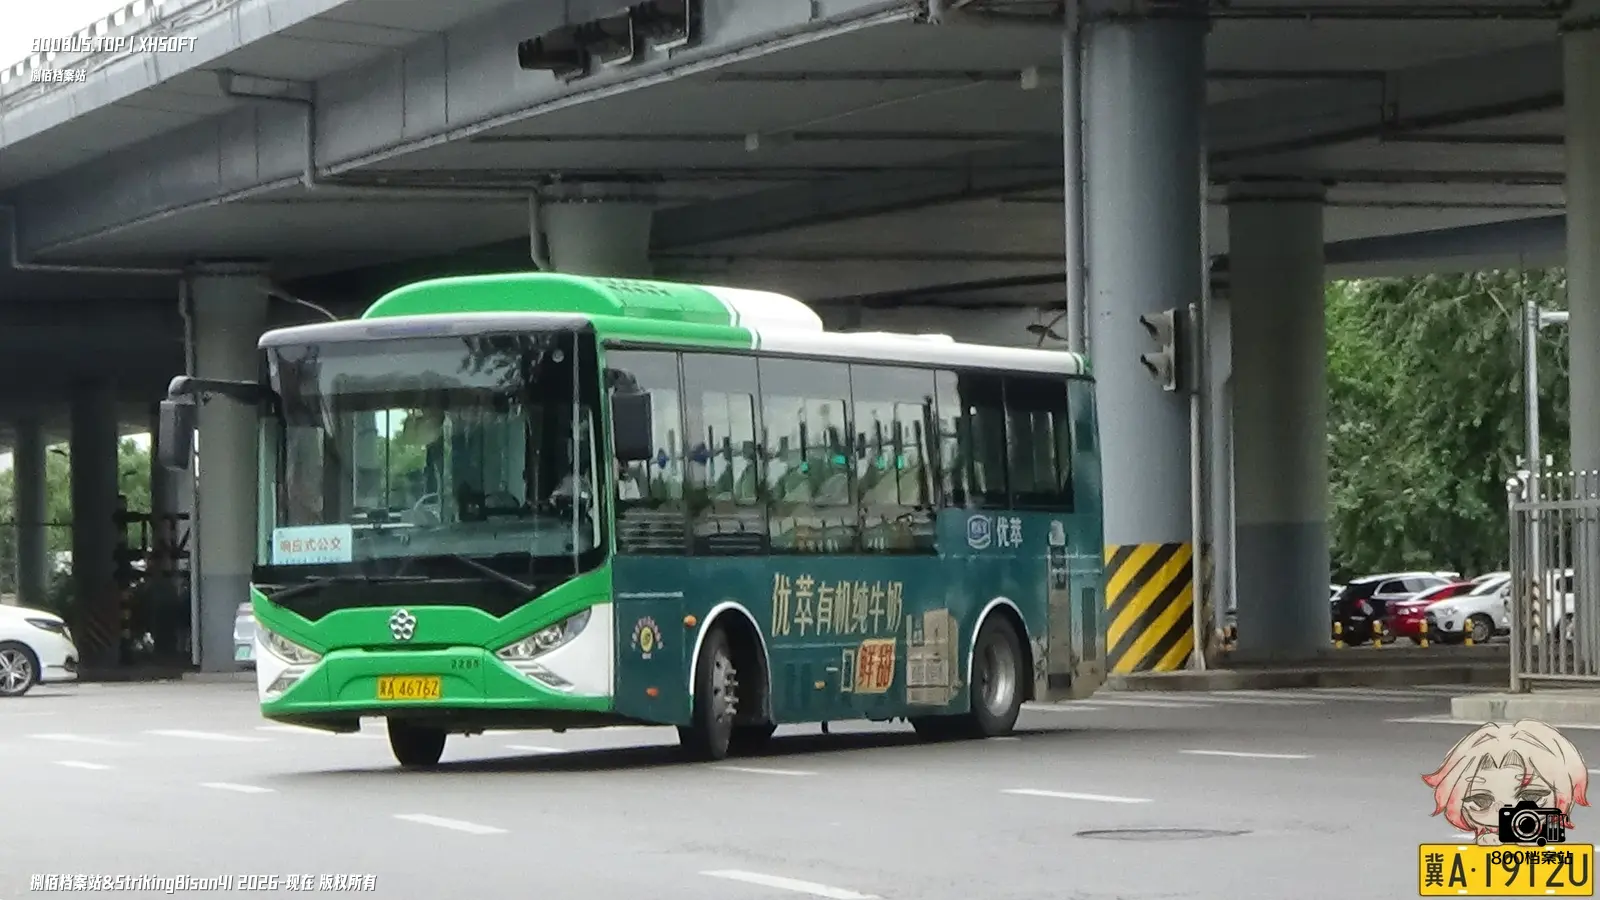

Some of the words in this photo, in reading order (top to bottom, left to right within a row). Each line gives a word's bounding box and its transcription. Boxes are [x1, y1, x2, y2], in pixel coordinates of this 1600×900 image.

[280, 537, 341, 552] 响应式公交
[997, 516, 1023, 548] 优萃
[772, 572, 903, 638] 优萃有机纯牛奶
